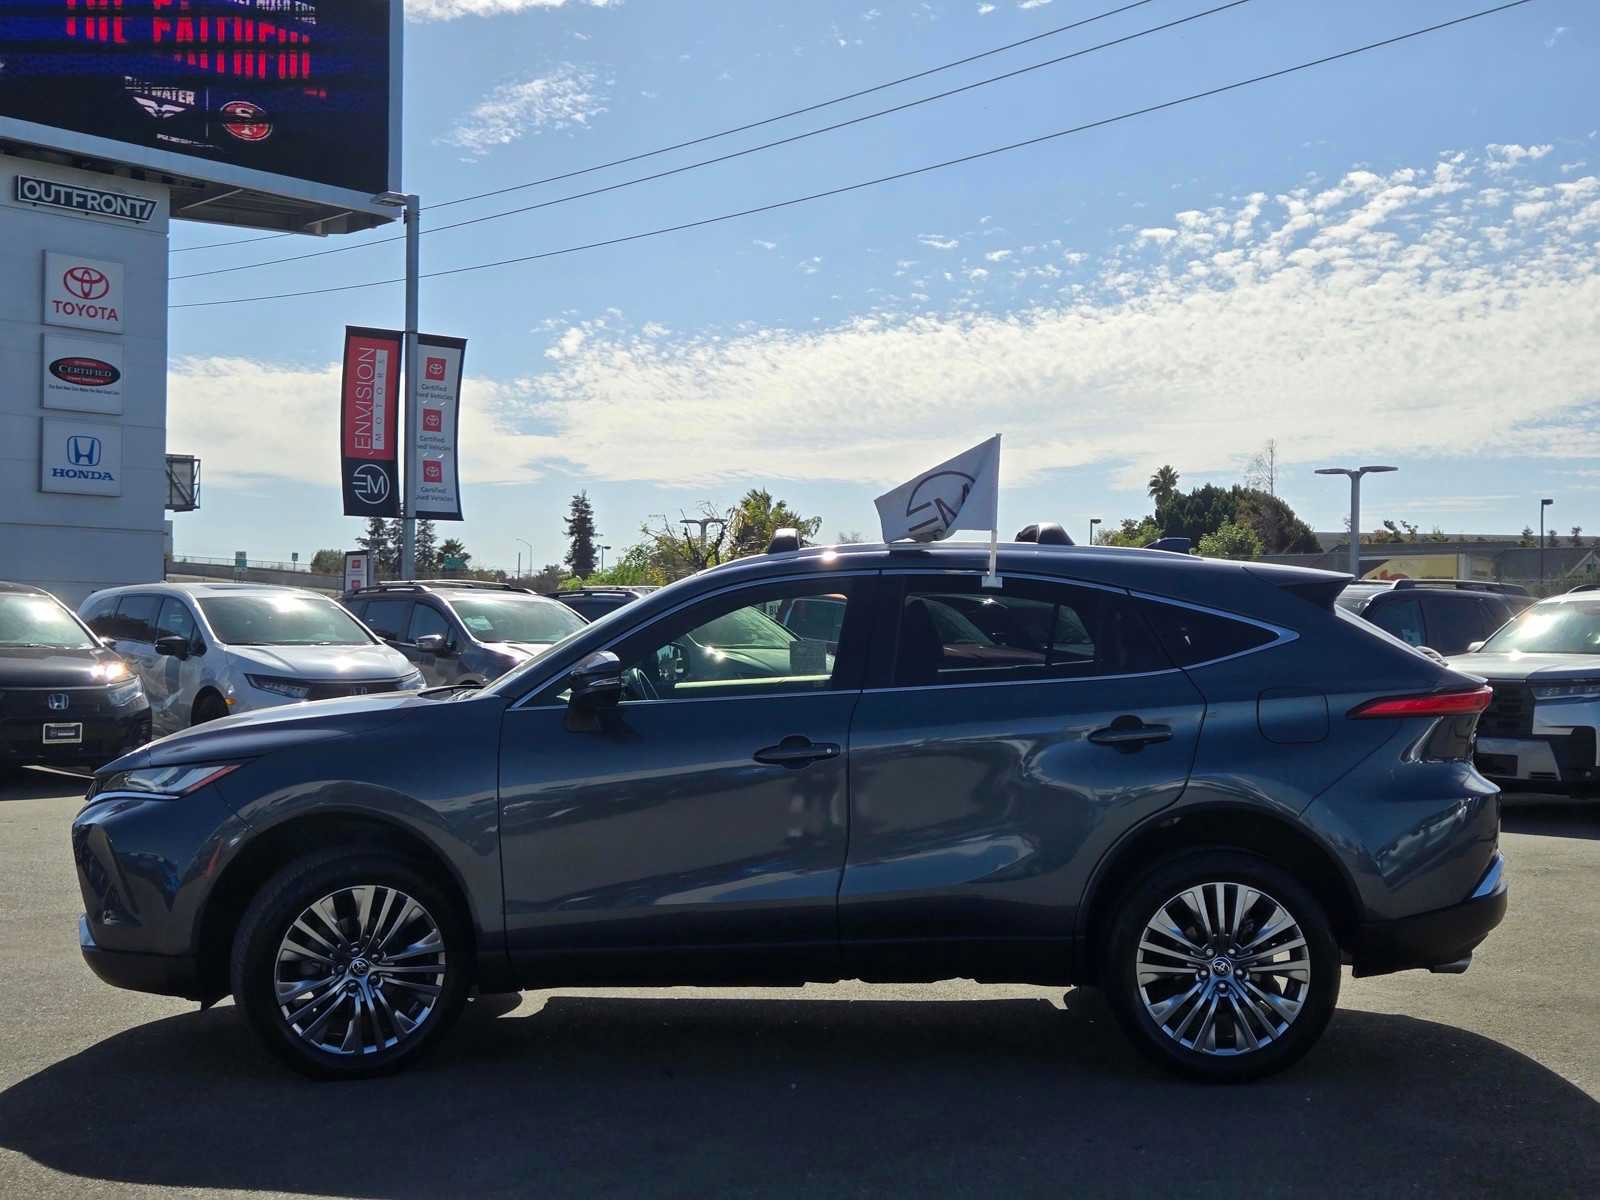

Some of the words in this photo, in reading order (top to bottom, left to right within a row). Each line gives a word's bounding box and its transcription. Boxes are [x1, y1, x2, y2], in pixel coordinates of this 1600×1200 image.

[52, 299, 119, 322] TOYOTA
[354, 347, 375, 449] ENVISION
[52, 467, 116, 481] HONDA
